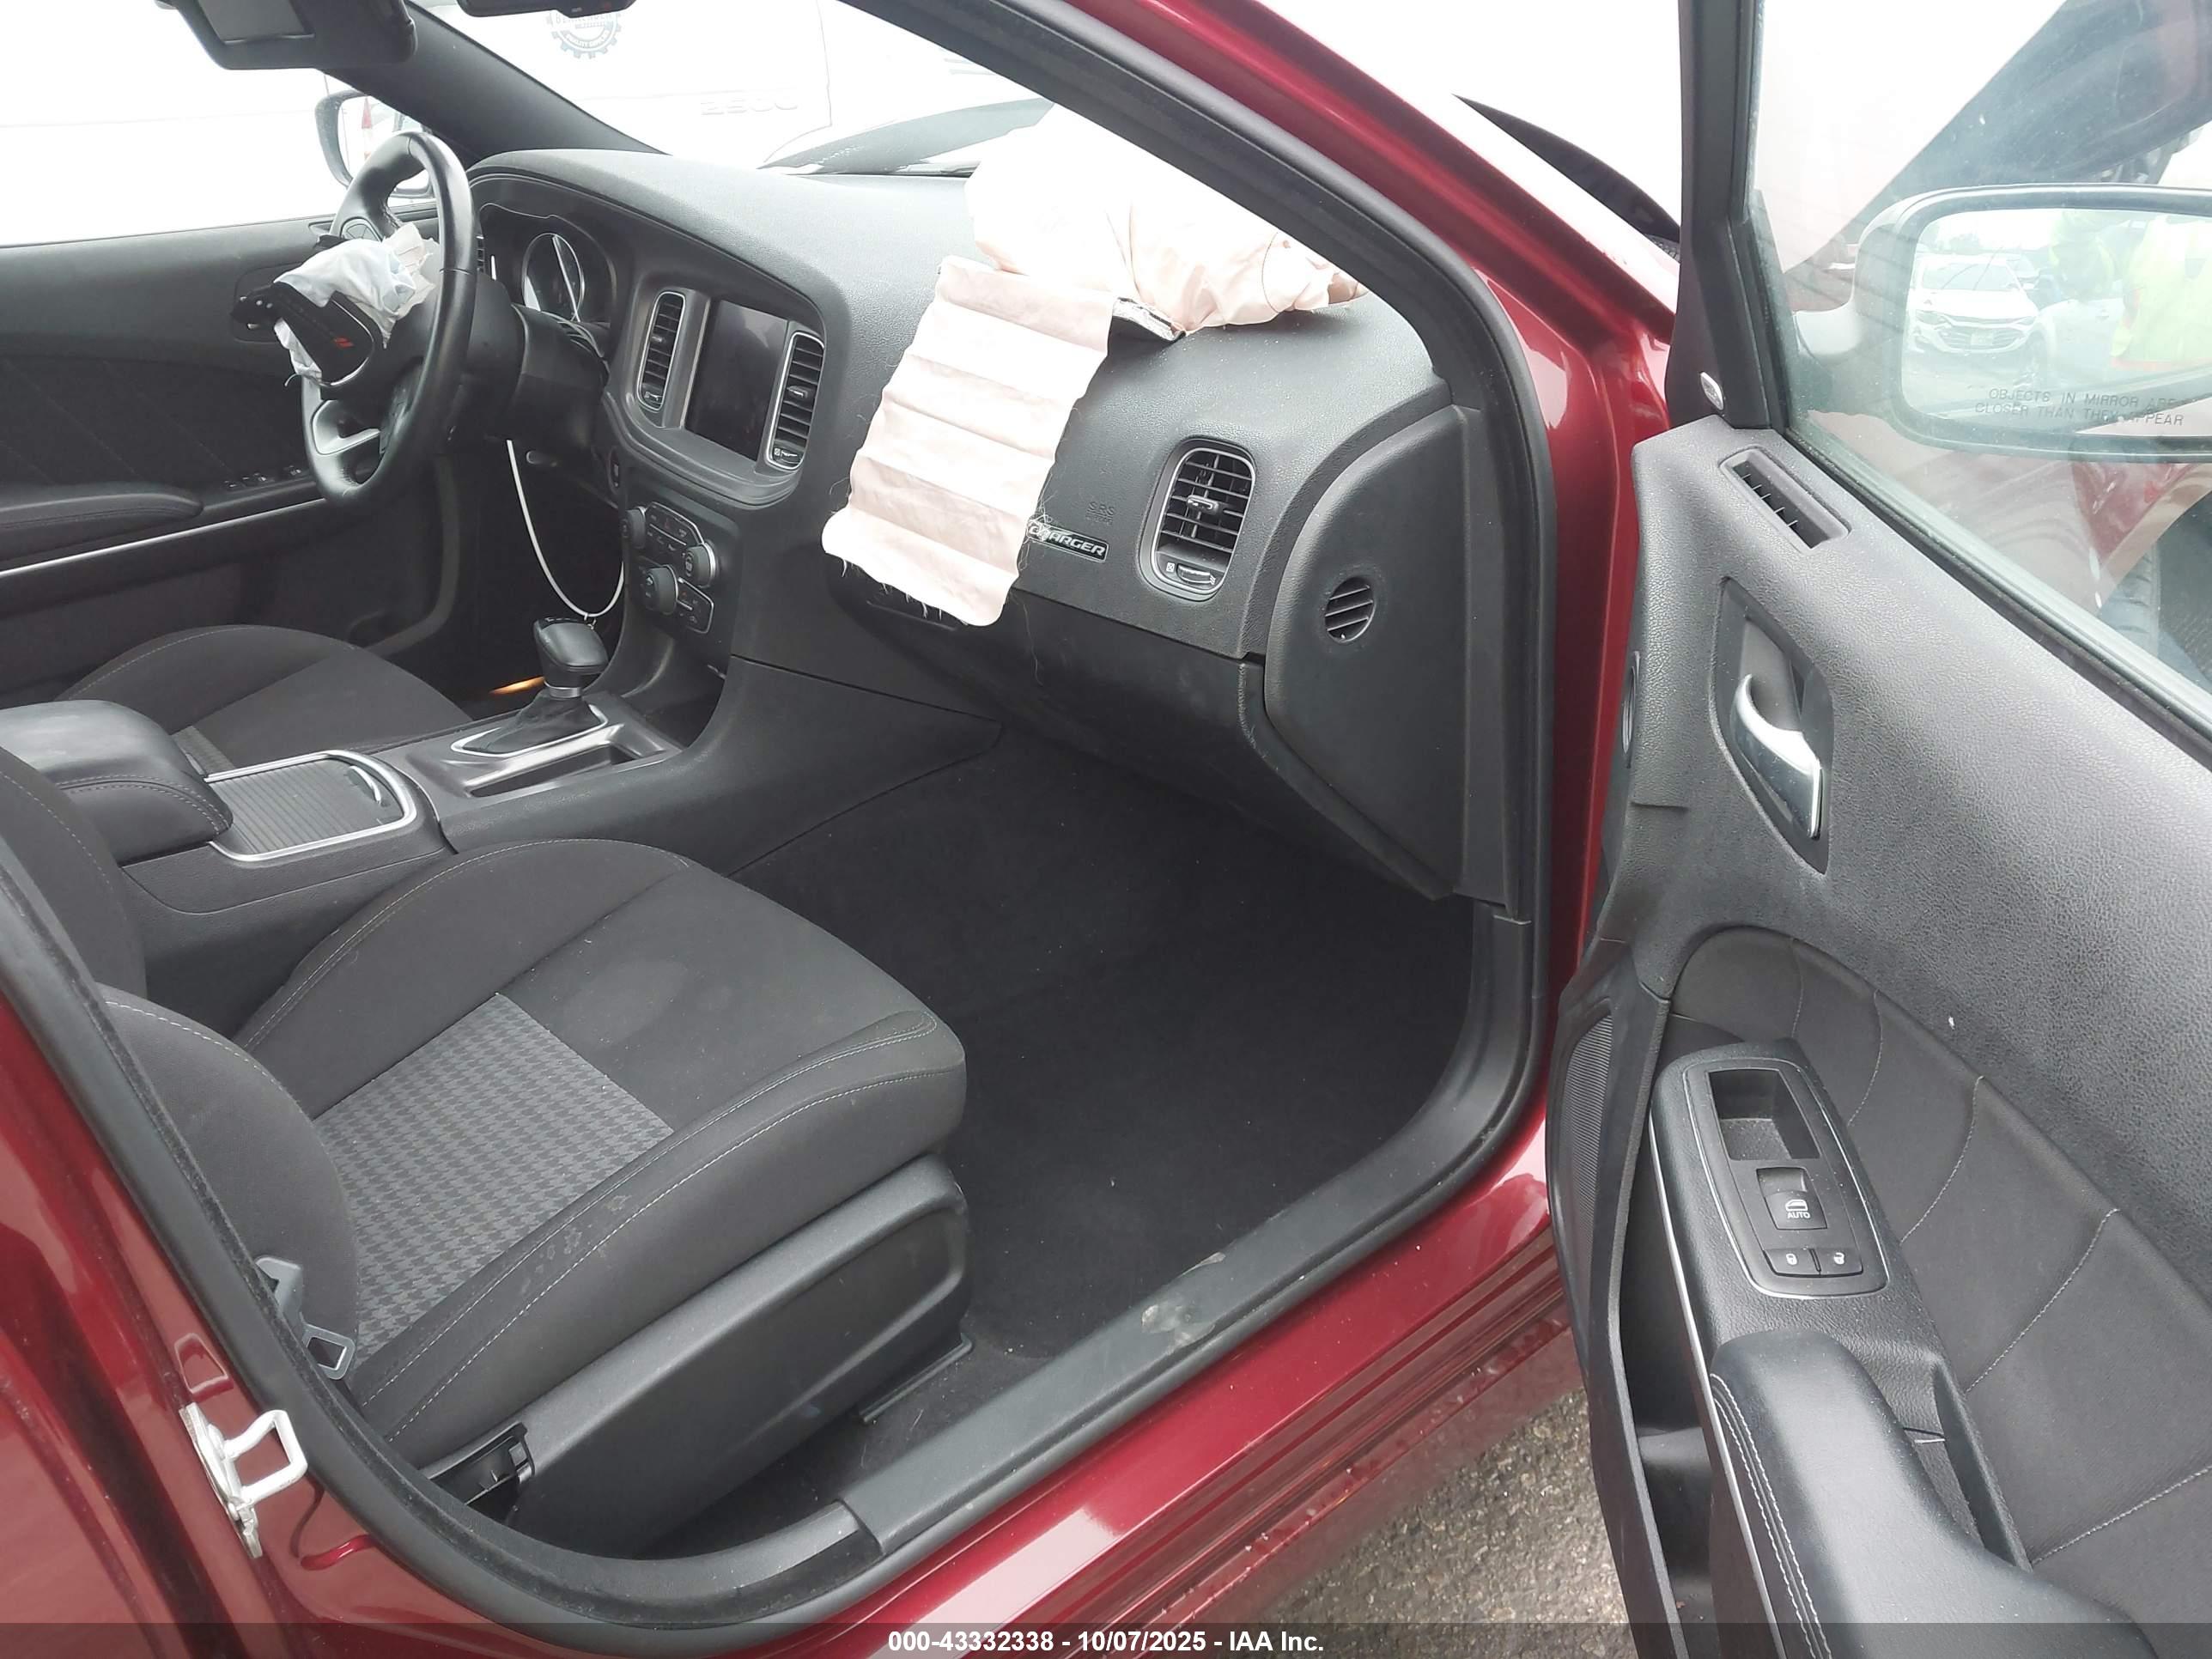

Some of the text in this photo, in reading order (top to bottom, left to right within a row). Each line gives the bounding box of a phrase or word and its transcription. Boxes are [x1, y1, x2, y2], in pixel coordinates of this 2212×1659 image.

[1989, 388, 2051, 403] OBJECTS
[2061, 391, 2076, 404] IN
[2083, 393, 2139, 407] MIRROR
[1975, 402, 2028, 416] CLOSER
[2037, 405, 2075, 419] THAN
[1787, 1211, 1811, 1219] AUTO
